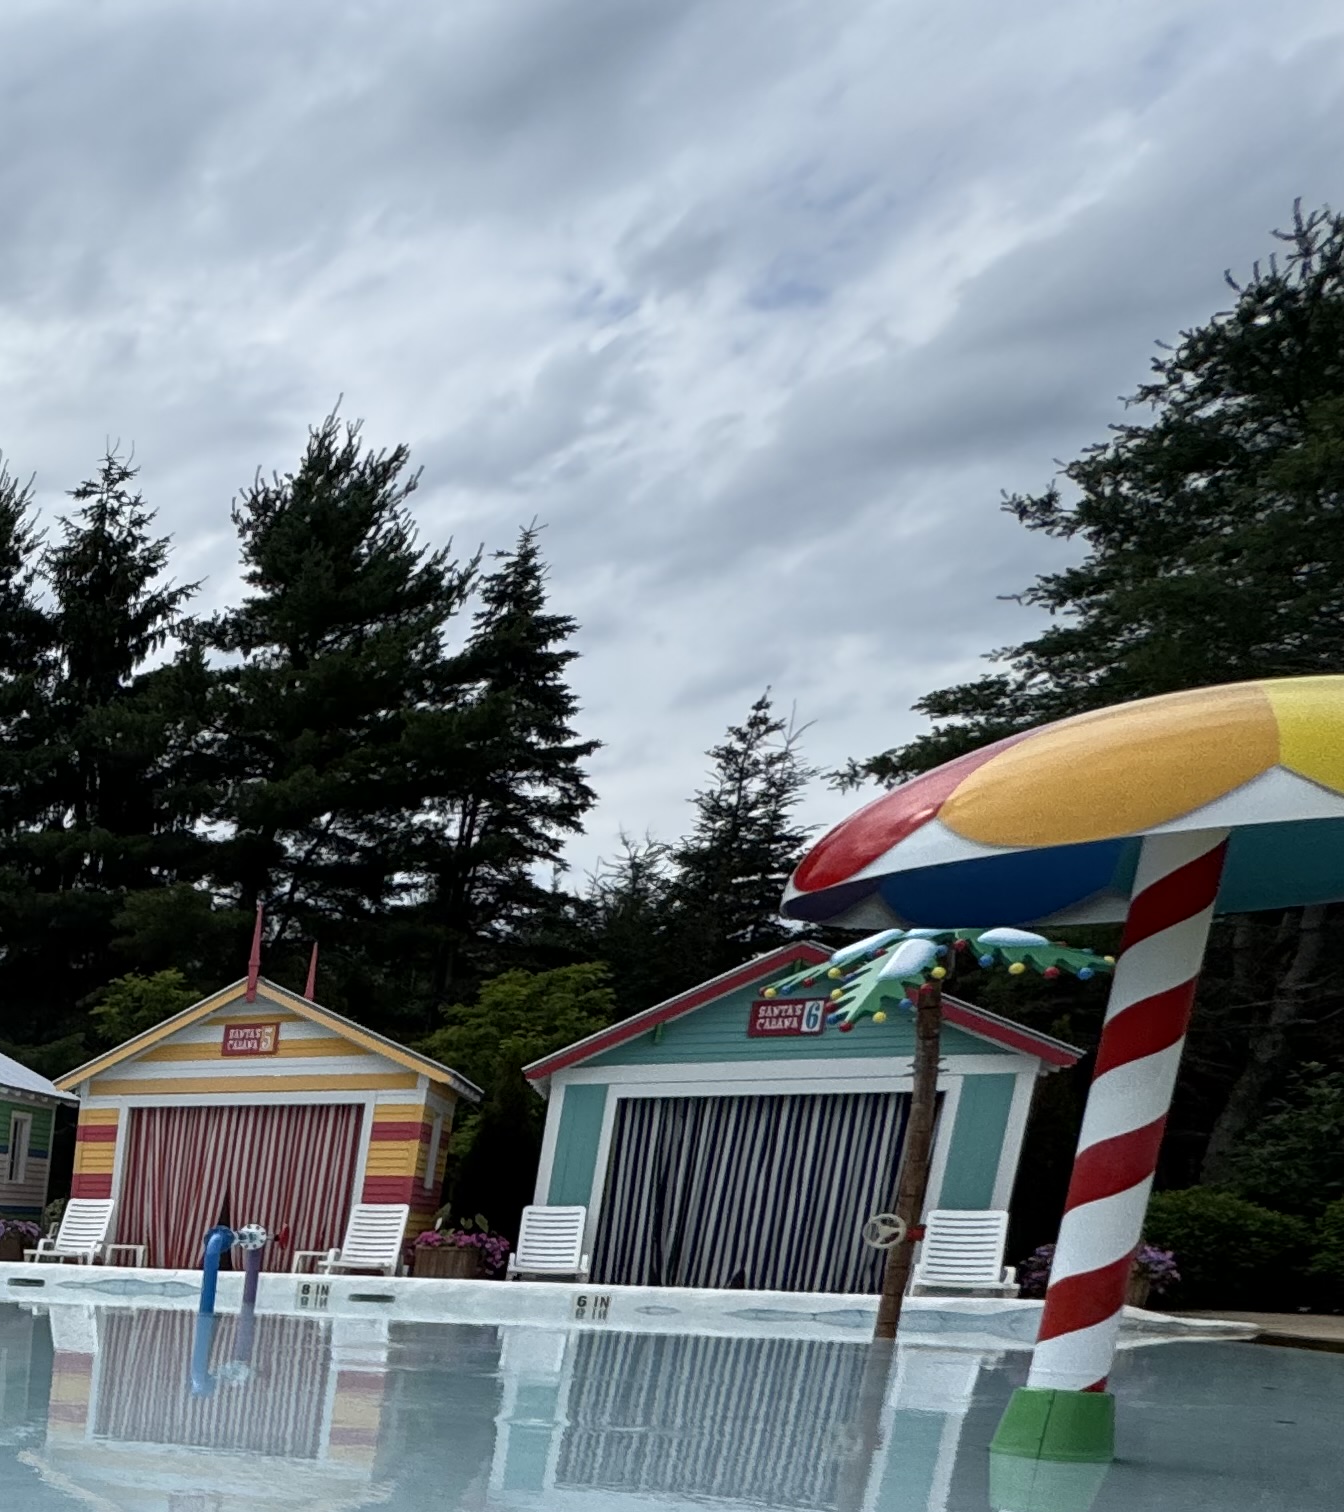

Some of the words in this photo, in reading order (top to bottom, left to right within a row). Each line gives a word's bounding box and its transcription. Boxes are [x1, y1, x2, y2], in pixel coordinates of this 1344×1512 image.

[805, 1001, 821, 1030] 6
[756, 1017, 799, 1030] CABANA
[261, 1027, 274, 1051] 5
[301, 1283, 311, 1295] 8
[315, 1284, 330, 1297] IN
[576, 1295, 588, 1308] 6
[593, 1295, 610, 1309] IN
